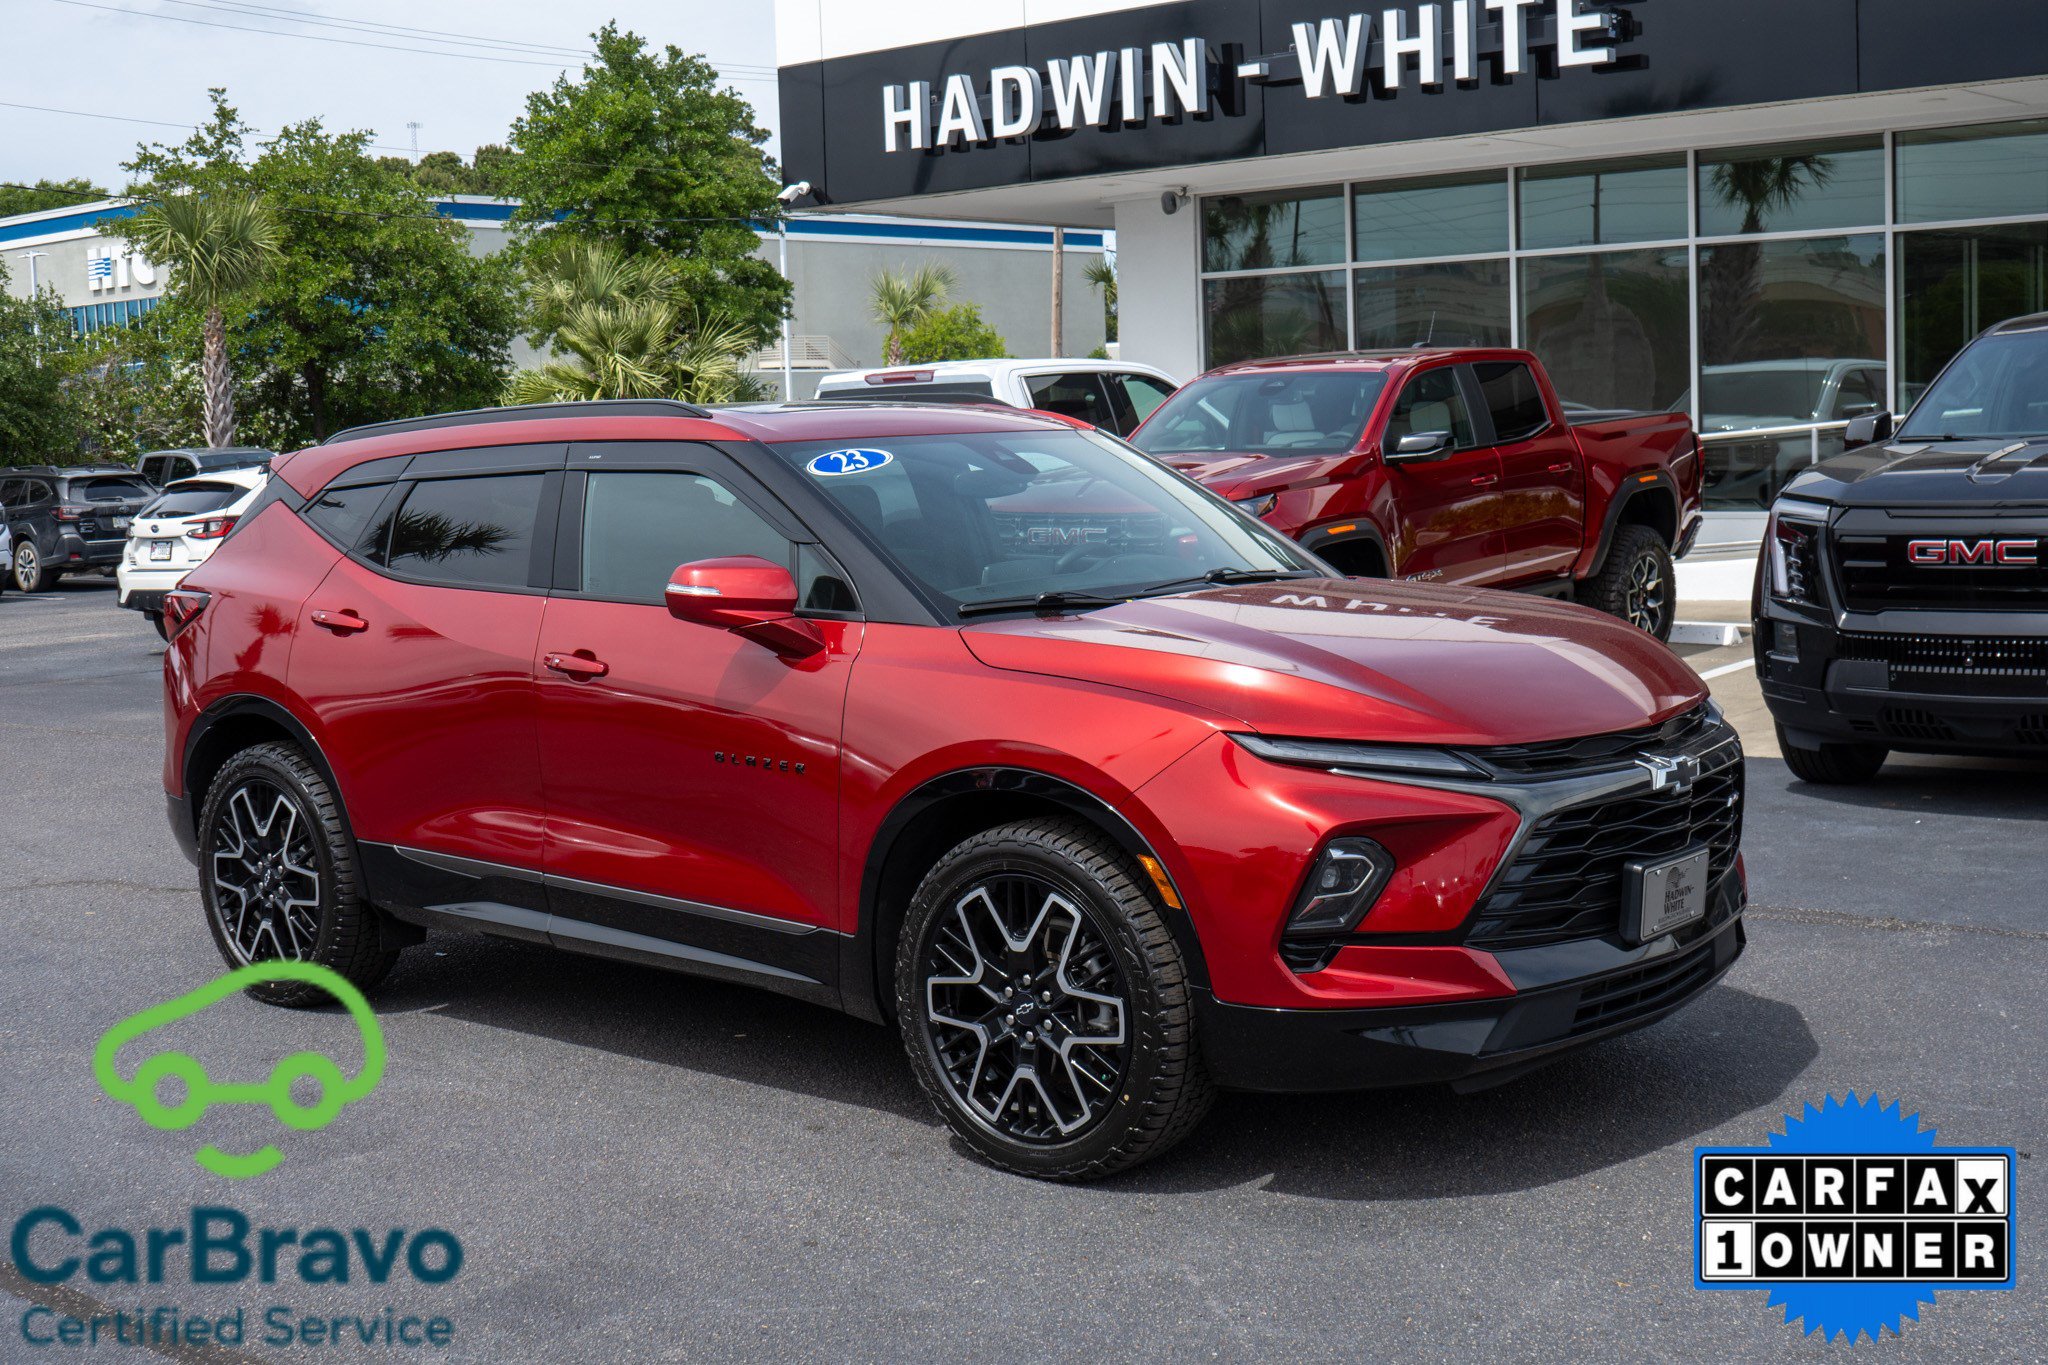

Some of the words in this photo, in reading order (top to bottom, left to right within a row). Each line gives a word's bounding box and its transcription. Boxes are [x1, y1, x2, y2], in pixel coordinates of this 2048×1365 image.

[883, 37, 1206, 153] HADWIN
[1291, 0, 1616, 99] WHITE
[829, 449, 869, 473] 23
[1027, 527, 1107, 545] GMC
[1907, 539, 2037, 564] GMC
[714, 750, 805, 775] BLAZER
[1664, 898, 1685, 915] WHITE
